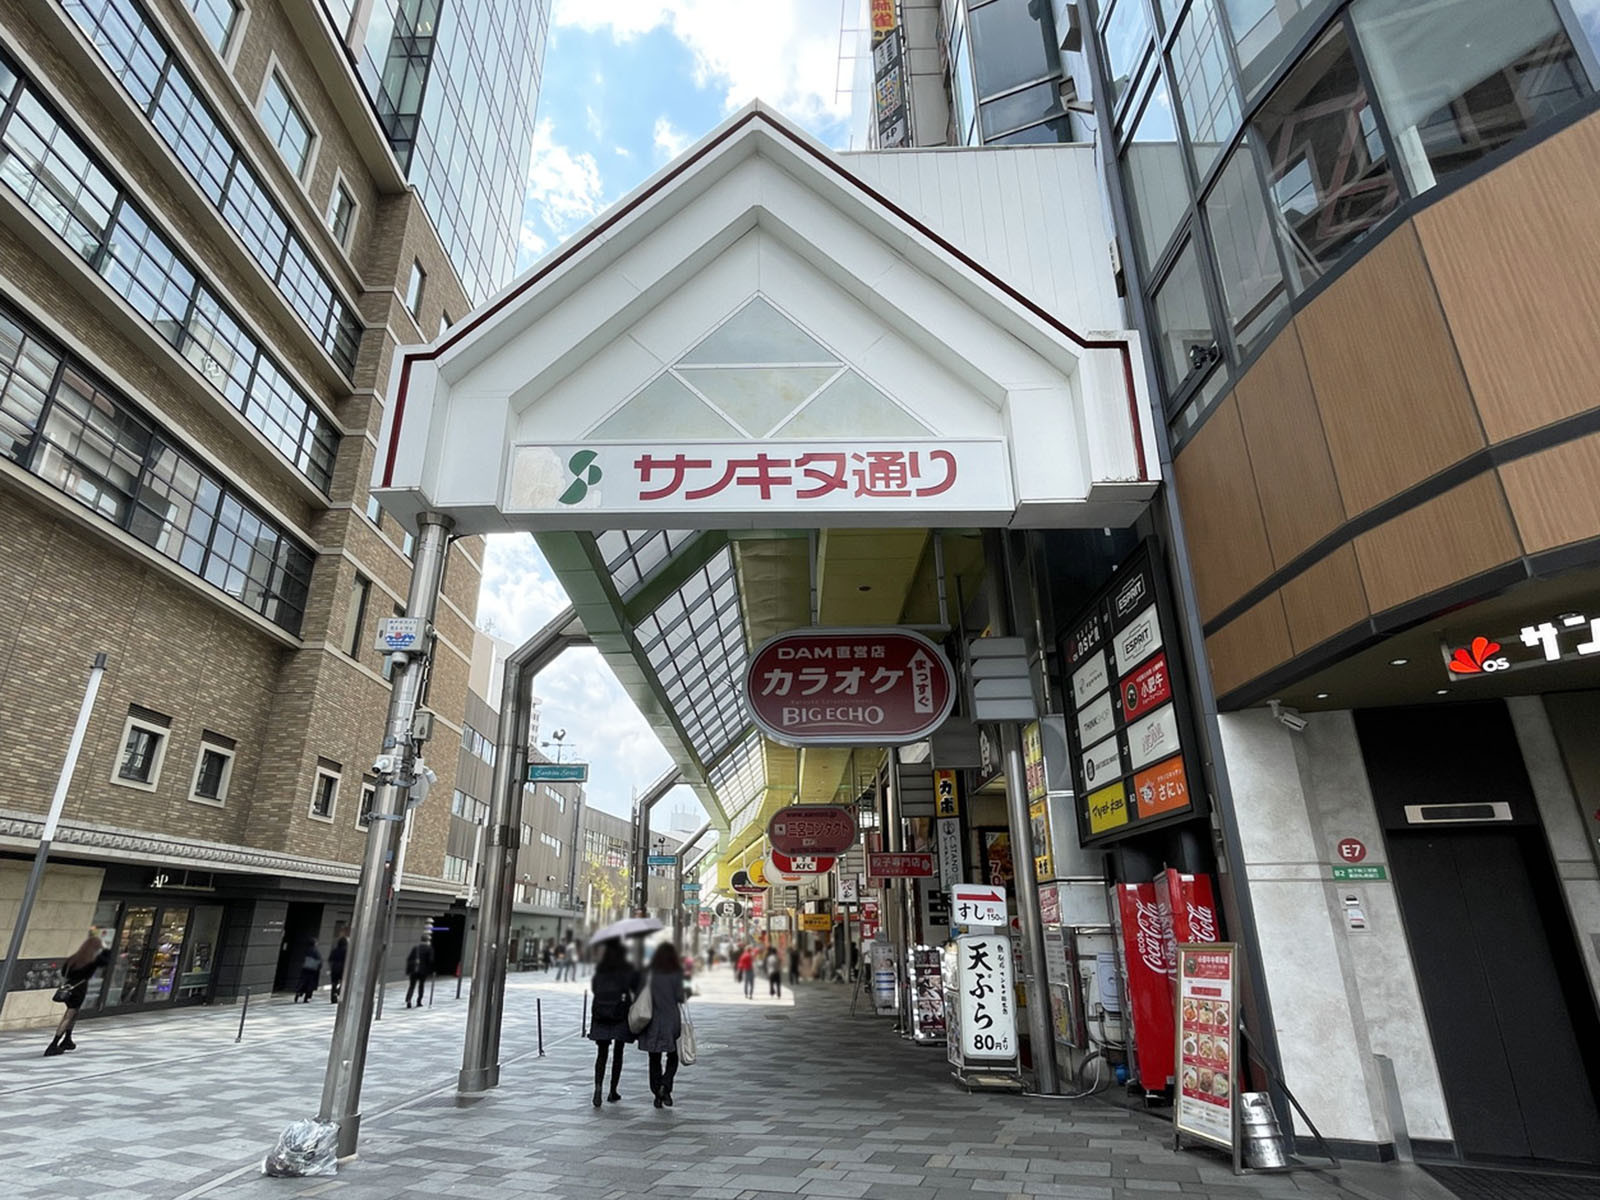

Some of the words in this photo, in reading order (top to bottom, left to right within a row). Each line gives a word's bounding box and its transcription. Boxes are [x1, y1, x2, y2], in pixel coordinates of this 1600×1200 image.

[634, 449, 957, 501] サンキタ通り
[1118, 581, 1142, 610] ESPRIT
[1125, 628, 1149, 654] ESPRIT
[761, 666, 904, 696] カラオケ
[1341, 844, 1361, 857] E7
[795, 862, 814, 870] KFC
[958, 902, 985, 921] すし
[1136, 897, 1167, 974] Coca-Cola
[967, 942, 994, 1030] 天ぷら
